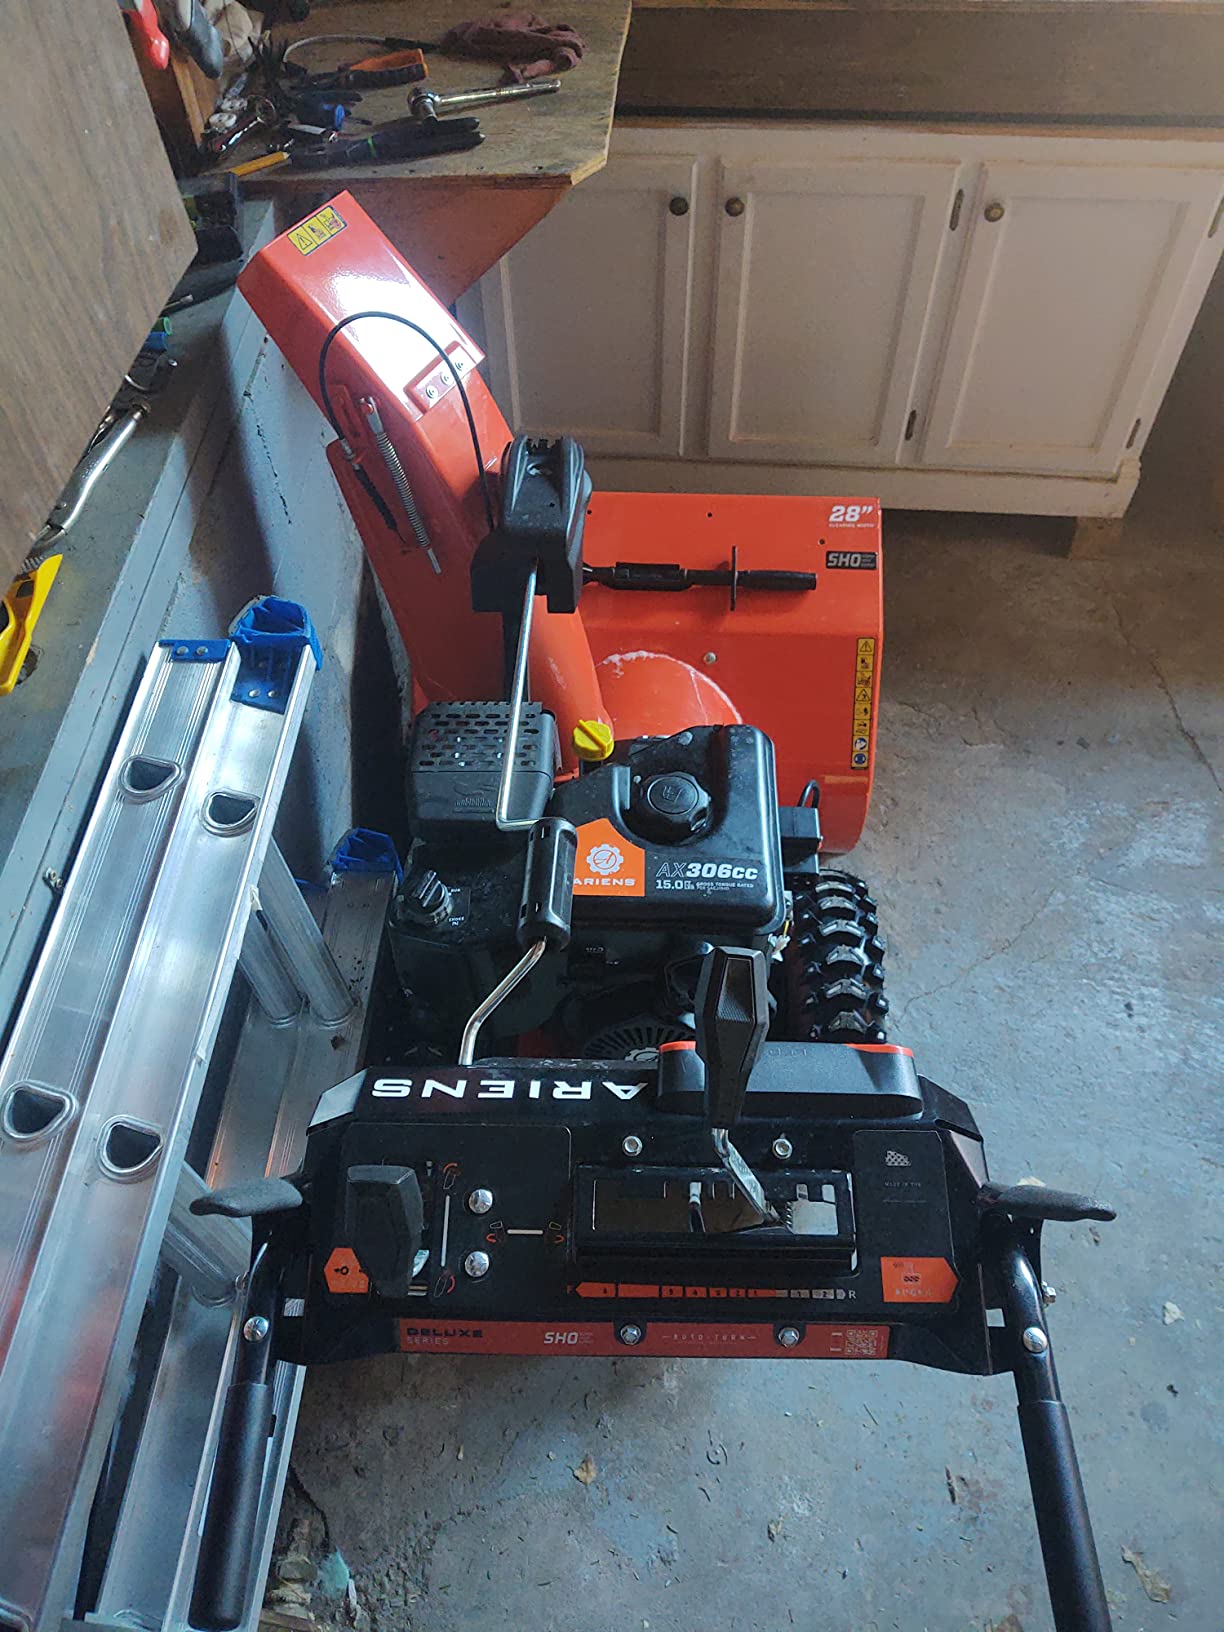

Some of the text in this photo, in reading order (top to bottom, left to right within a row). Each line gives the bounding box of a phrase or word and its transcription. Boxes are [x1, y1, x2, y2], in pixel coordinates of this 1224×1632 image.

[827, 552, 861, 567] SHO
[655, 862, 759, 879] AX306cc
[573, 877, 636, 886] ARIENS
[656, 880, 683, 890] 15.0
[371, 1078, 648, 1100] ARIENS
[848, 1290, 857, 1299] R
[406, 1327, 483, 1338] DELUXE
[543, 1331, 579, 1345] SHO
[407, 1336, 450, 1345] SERIES
